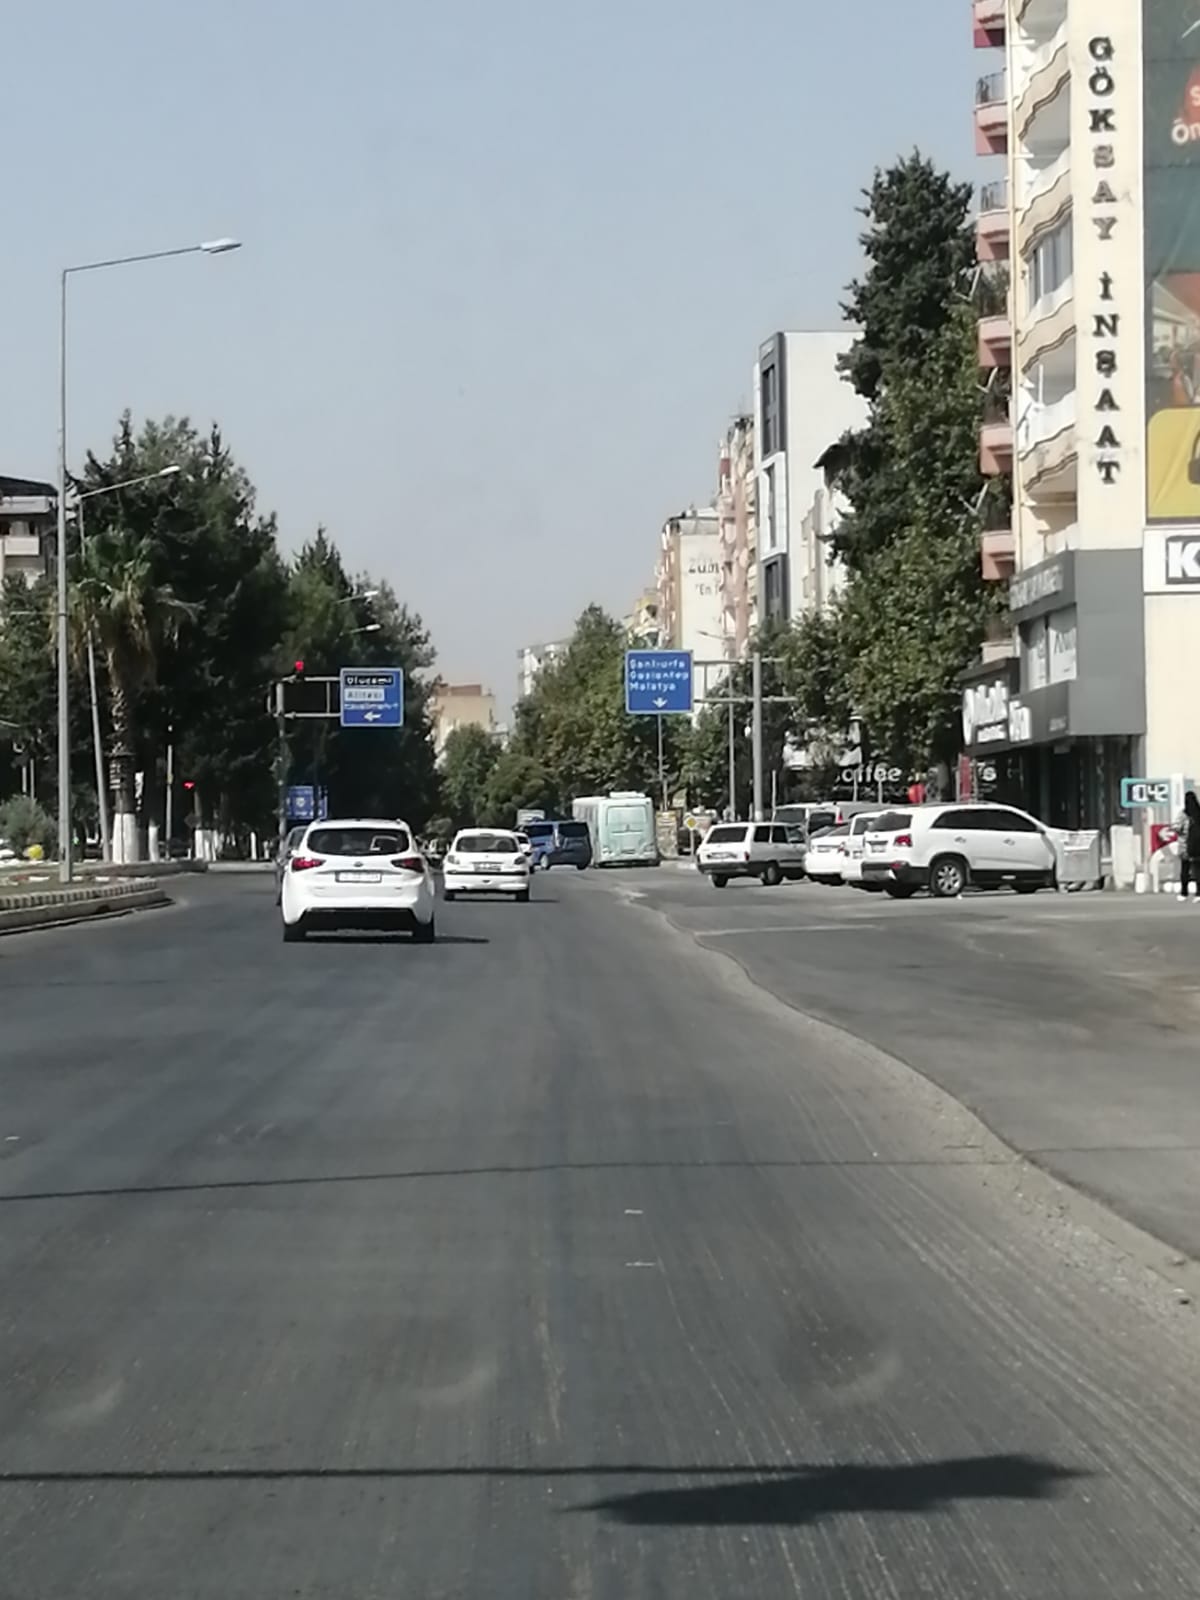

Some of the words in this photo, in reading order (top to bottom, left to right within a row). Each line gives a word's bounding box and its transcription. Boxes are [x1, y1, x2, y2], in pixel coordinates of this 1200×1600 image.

[1088, 36, 1117, 241] GÖKSAY
[1092, 270, 1121, 485] İNŞAAT
[629, 681, 676, 693] Malatya
